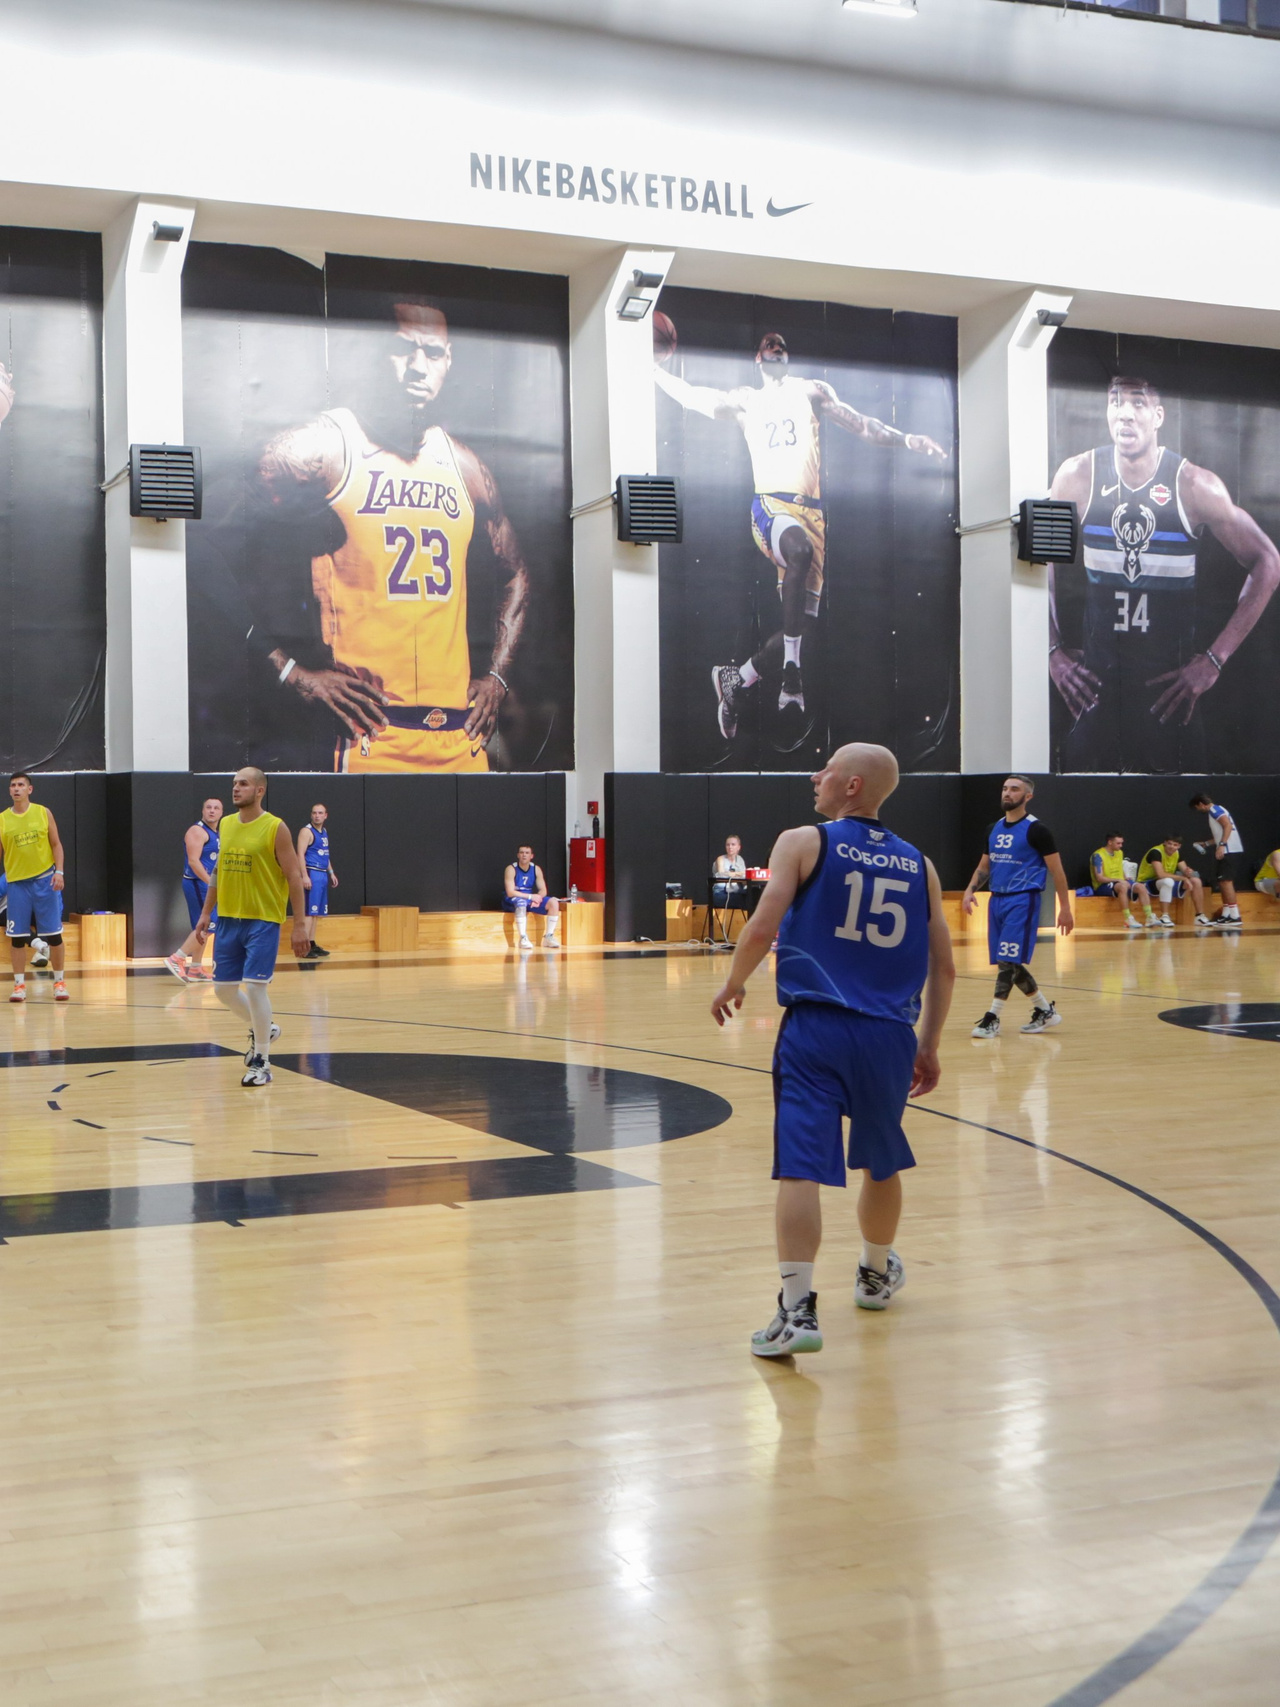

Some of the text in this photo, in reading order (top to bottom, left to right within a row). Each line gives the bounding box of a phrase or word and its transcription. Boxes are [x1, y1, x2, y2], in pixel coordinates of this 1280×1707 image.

[470, 152, 754, 219] NIKEBASKETBALL
[765, 418, 797, 449] 23
[356, 470, 461, 519] LAKERS
[383, 525, 453, 600] 23
[1113, 591, 1150, 633] 34
[836, 843, 918, 874] СОБОЛЕВ
[994, 834, 1014, 849] 33
[522, 876, 529, 885] 7
[834, 870, 910, 949] 15
[998, 942, 1020, 958] 33
